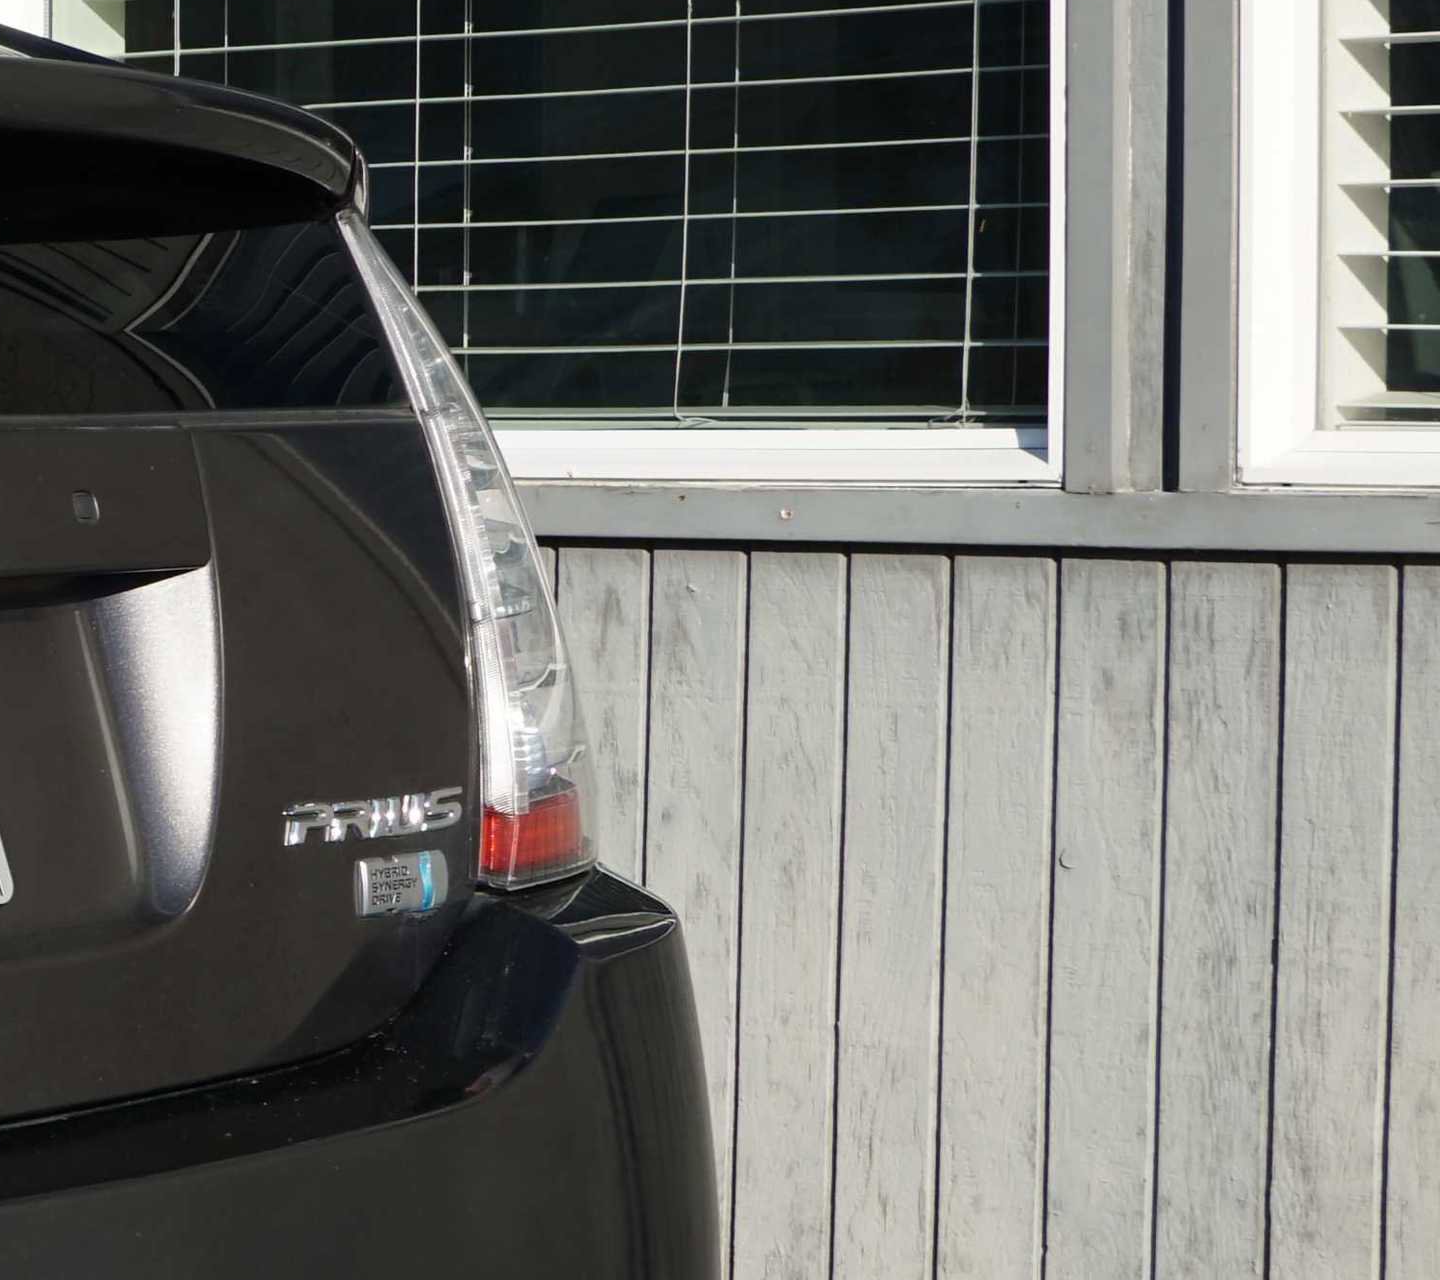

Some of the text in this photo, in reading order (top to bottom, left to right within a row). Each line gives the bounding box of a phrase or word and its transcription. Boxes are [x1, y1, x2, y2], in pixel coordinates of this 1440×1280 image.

[282, 786, 463, 846] PRIUS
[371, 865, 409, 881] HYBRID
[372, 877, 418, 894] SYNERGY
[372, 892, 401, 906] DRIVE
